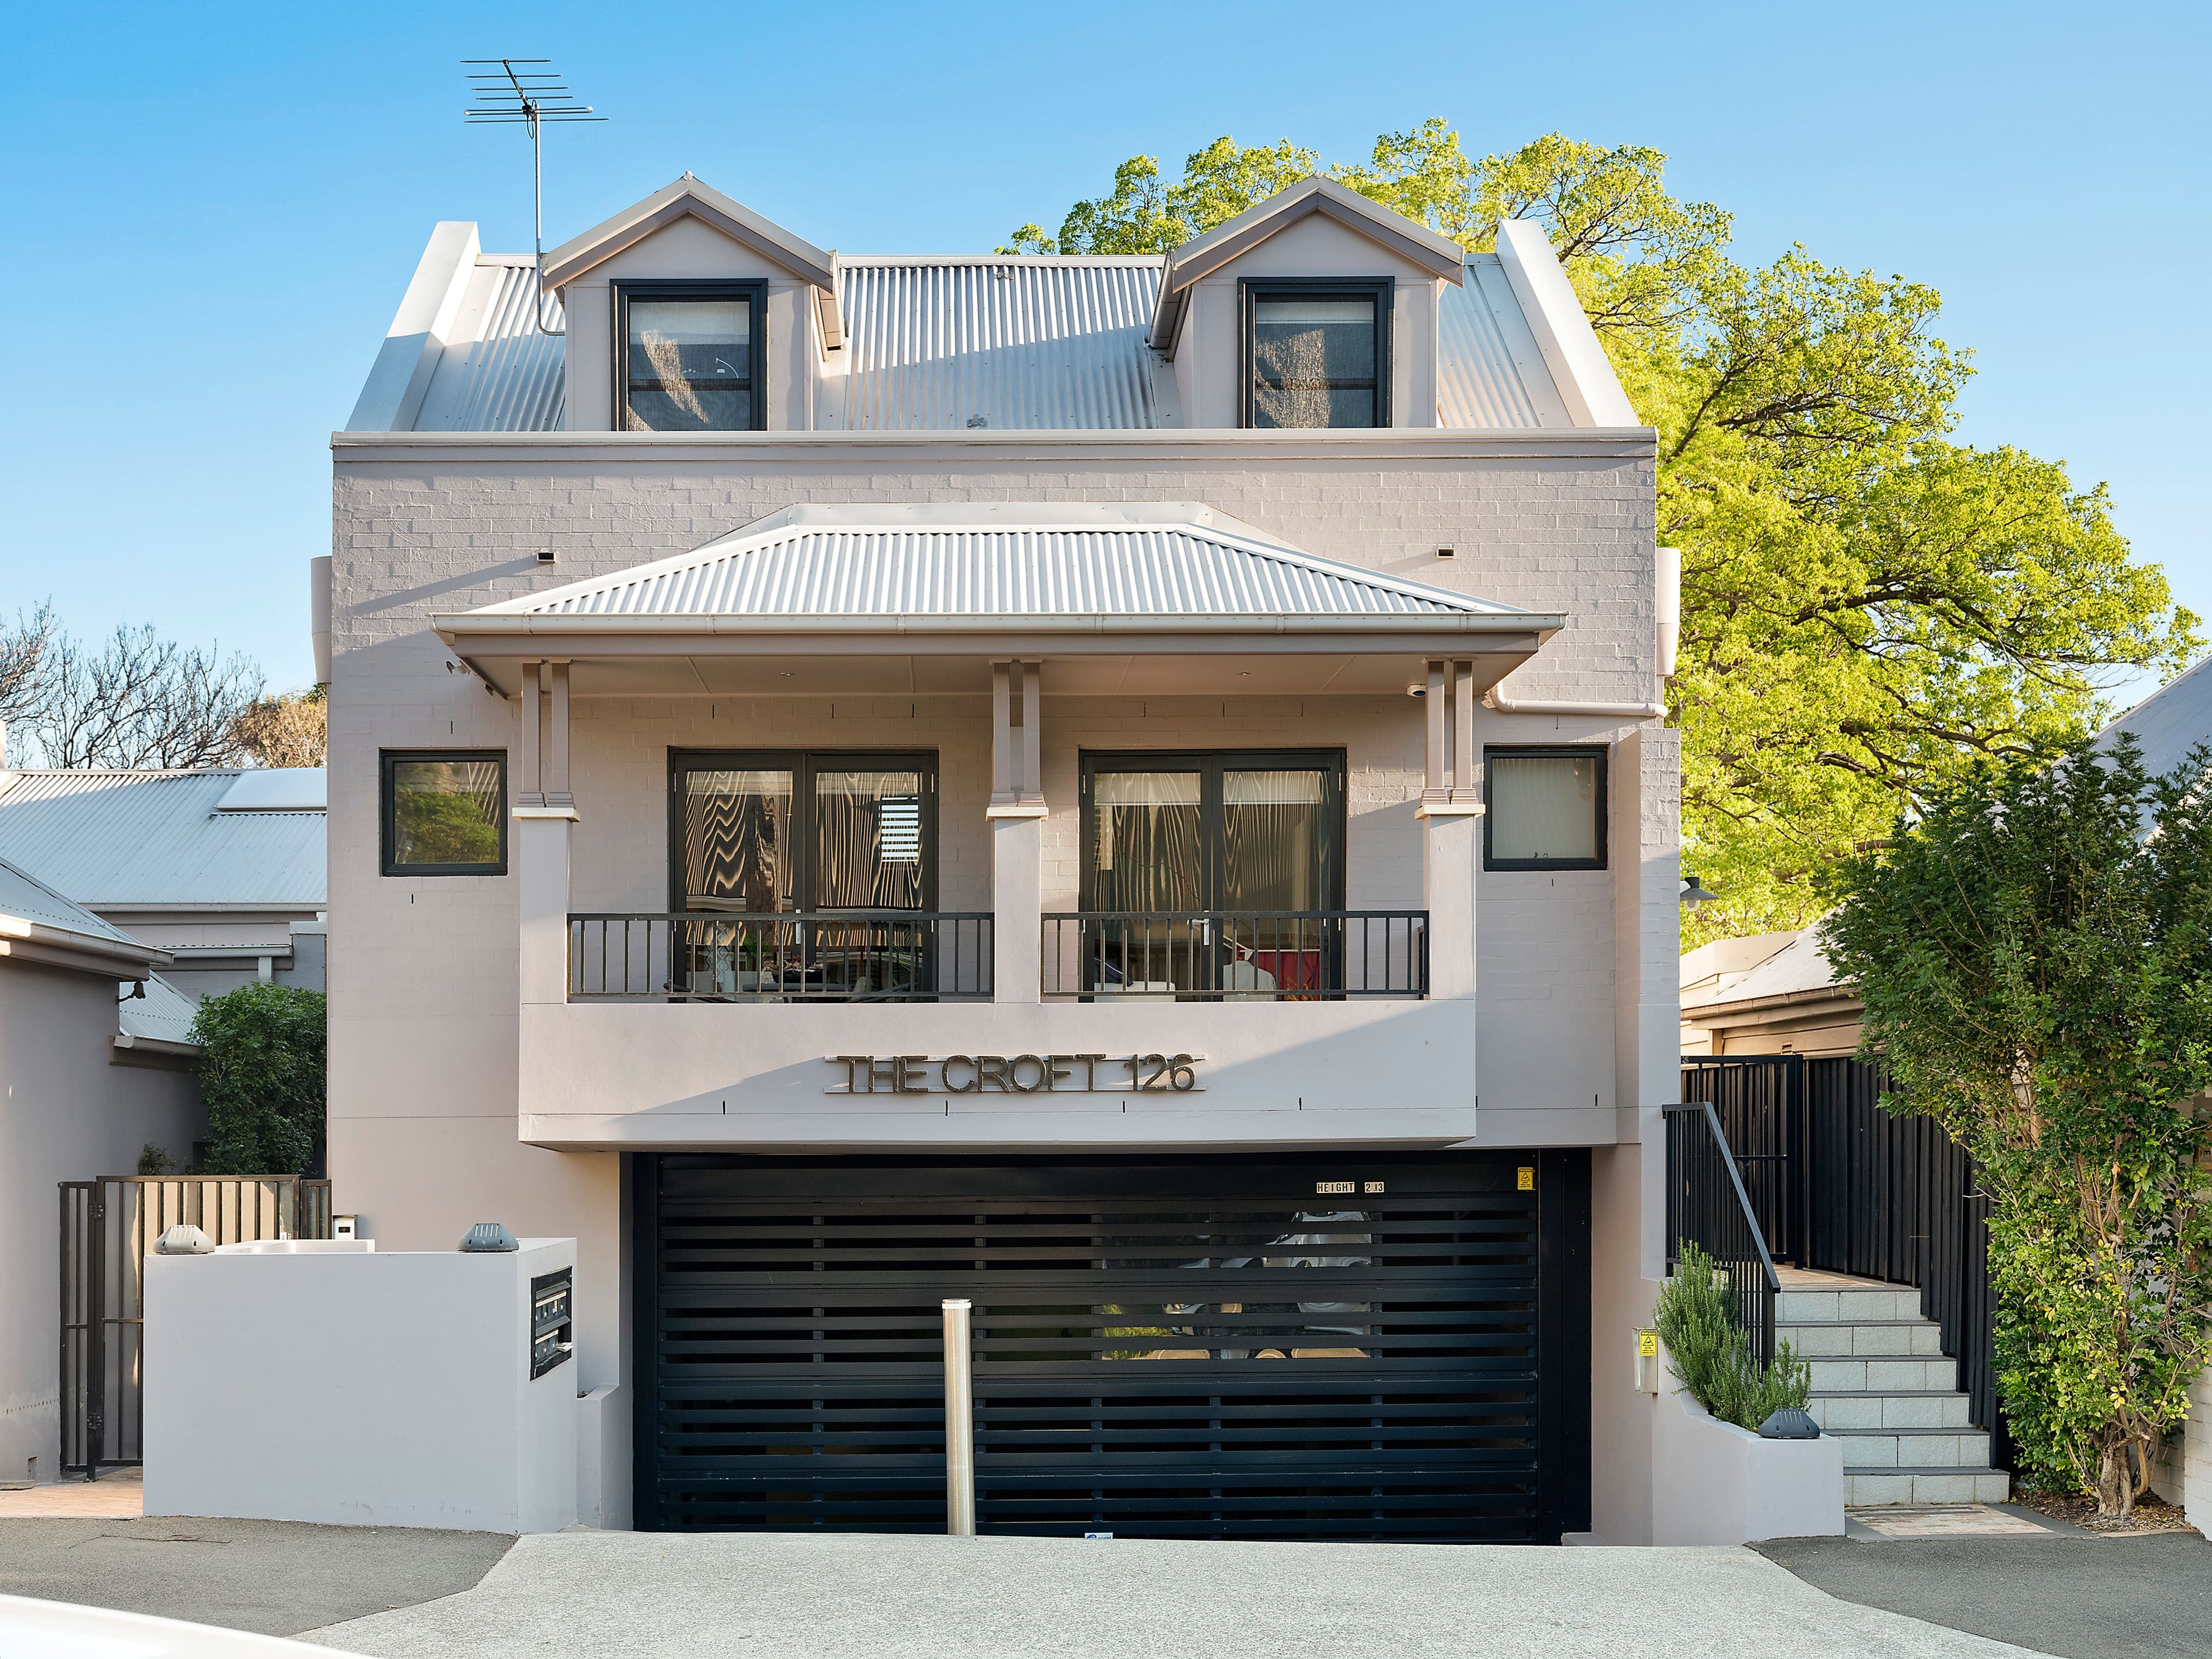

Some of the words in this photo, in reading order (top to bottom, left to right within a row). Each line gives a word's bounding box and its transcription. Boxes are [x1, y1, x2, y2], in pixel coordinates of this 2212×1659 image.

[837, 1055, 929, 1093] THE
[942, 1054, 1106, 1093] CROFT
[1123, 1054, 1196, 1092] 126
[1317, 1183, 1354, 1192] HEIGHT
[1366, 1183, 1383, 1191] 2.13
